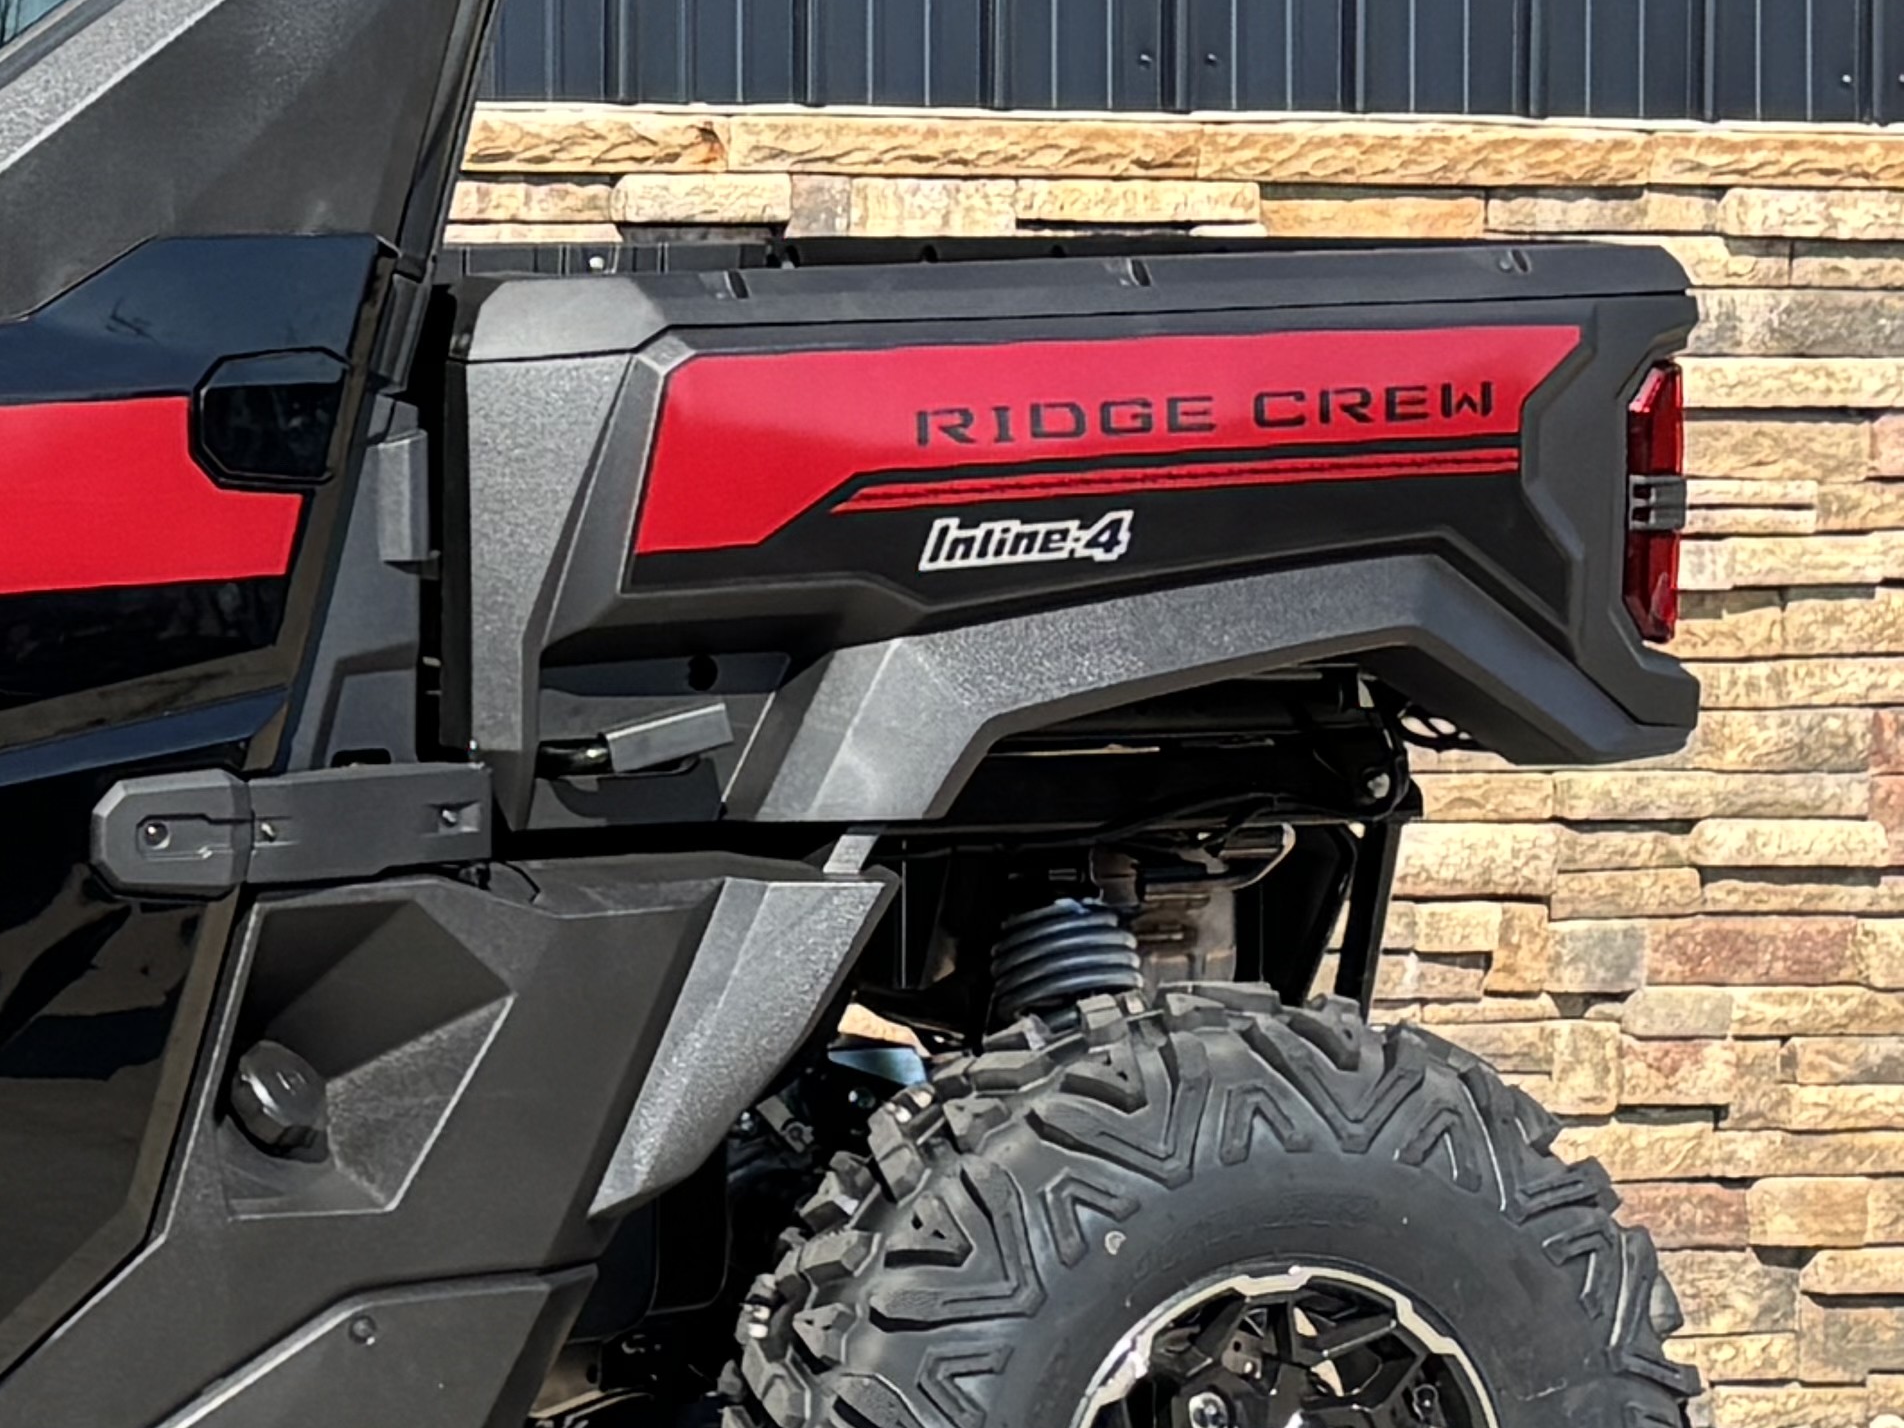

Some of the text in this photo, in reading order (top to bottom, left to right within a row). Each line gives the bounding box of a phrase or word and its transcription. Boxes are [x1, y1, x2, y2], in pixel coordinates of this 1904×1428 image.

[916, 378, 1496, 447] RIDGE CREW
[921, 511, 1131, 569] Inline-4
